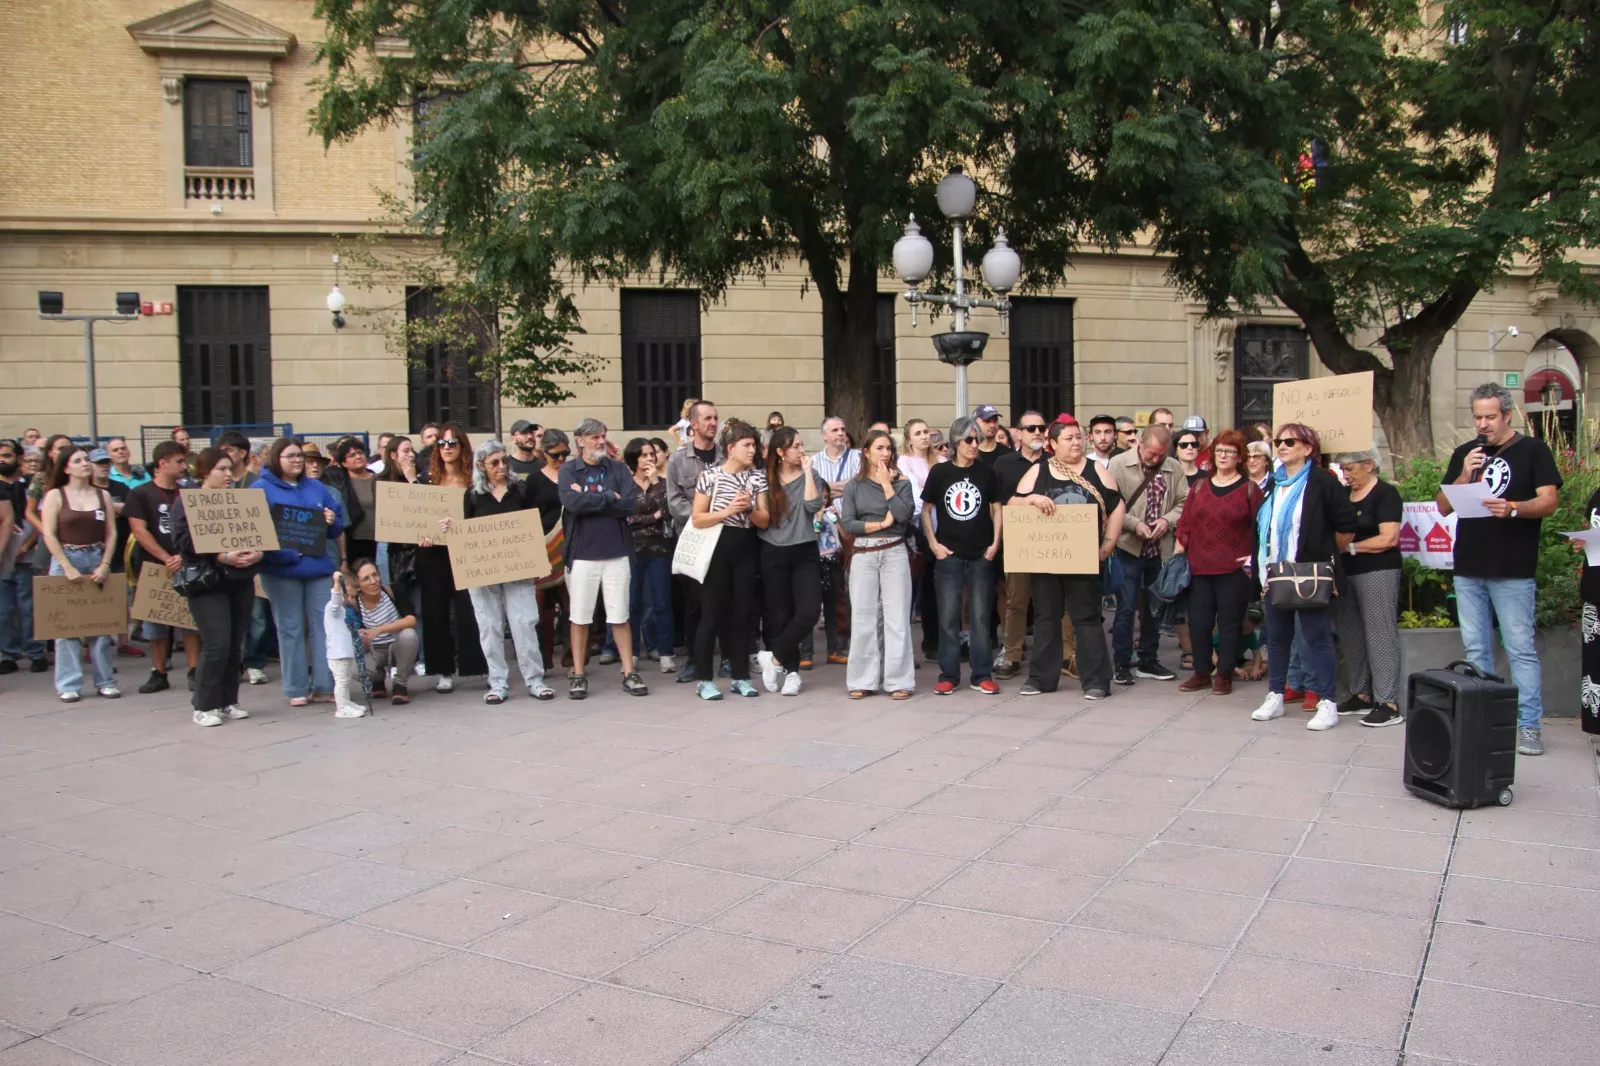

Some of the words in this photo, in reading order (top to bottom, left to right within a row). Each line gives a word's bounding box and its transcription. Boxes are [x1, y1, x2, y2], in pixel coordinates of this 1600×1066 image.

[1280, 388, 1300, 405] NO
[1307, 392, 1319, 401] AL
[1324, 387, 1361, 399] NEGOCIO
[388, 487, 403, 500] EL
[945, 481, 981, 498] LIBERTAD
[187, 494, 197, 508] SI
[199, 493, 223, 505] PAGO
[226, 492, 239, 505] EL
[197, 508, 241, 521] ALQUILER
[246, 507, 260, 518] NO
[282, 506, 313, 524] STOP
[1010, 512, 1033, 524] SUS
[1036, 512, 1091, 524] NEGOCIOS
[193, 523, 224, 536] TENGO
[229, 522, 258, 533] PARA
[450, 524, 463, 536] NI
[467, 519, 523, 535] ALQUILERES
[220, 536, 264, 549] COMER
[464, 540, 482, 550] POR
[483, 537, 499, 549] LAS
[502, 532, 534, 545] NUBES
[1028, 532, 1068, 543] NUESTRA
[455, 554, 468, 565] NI
[474, 549, 521, 563] SALARIOS
[1018, 547, 1073, 560] MISERIA
[148, 568, 159, 578] LA
[466, 568, 484, 578] POR
[504, 560, 536, 573] SUELOS
[161, 602, 174, 611] NO
